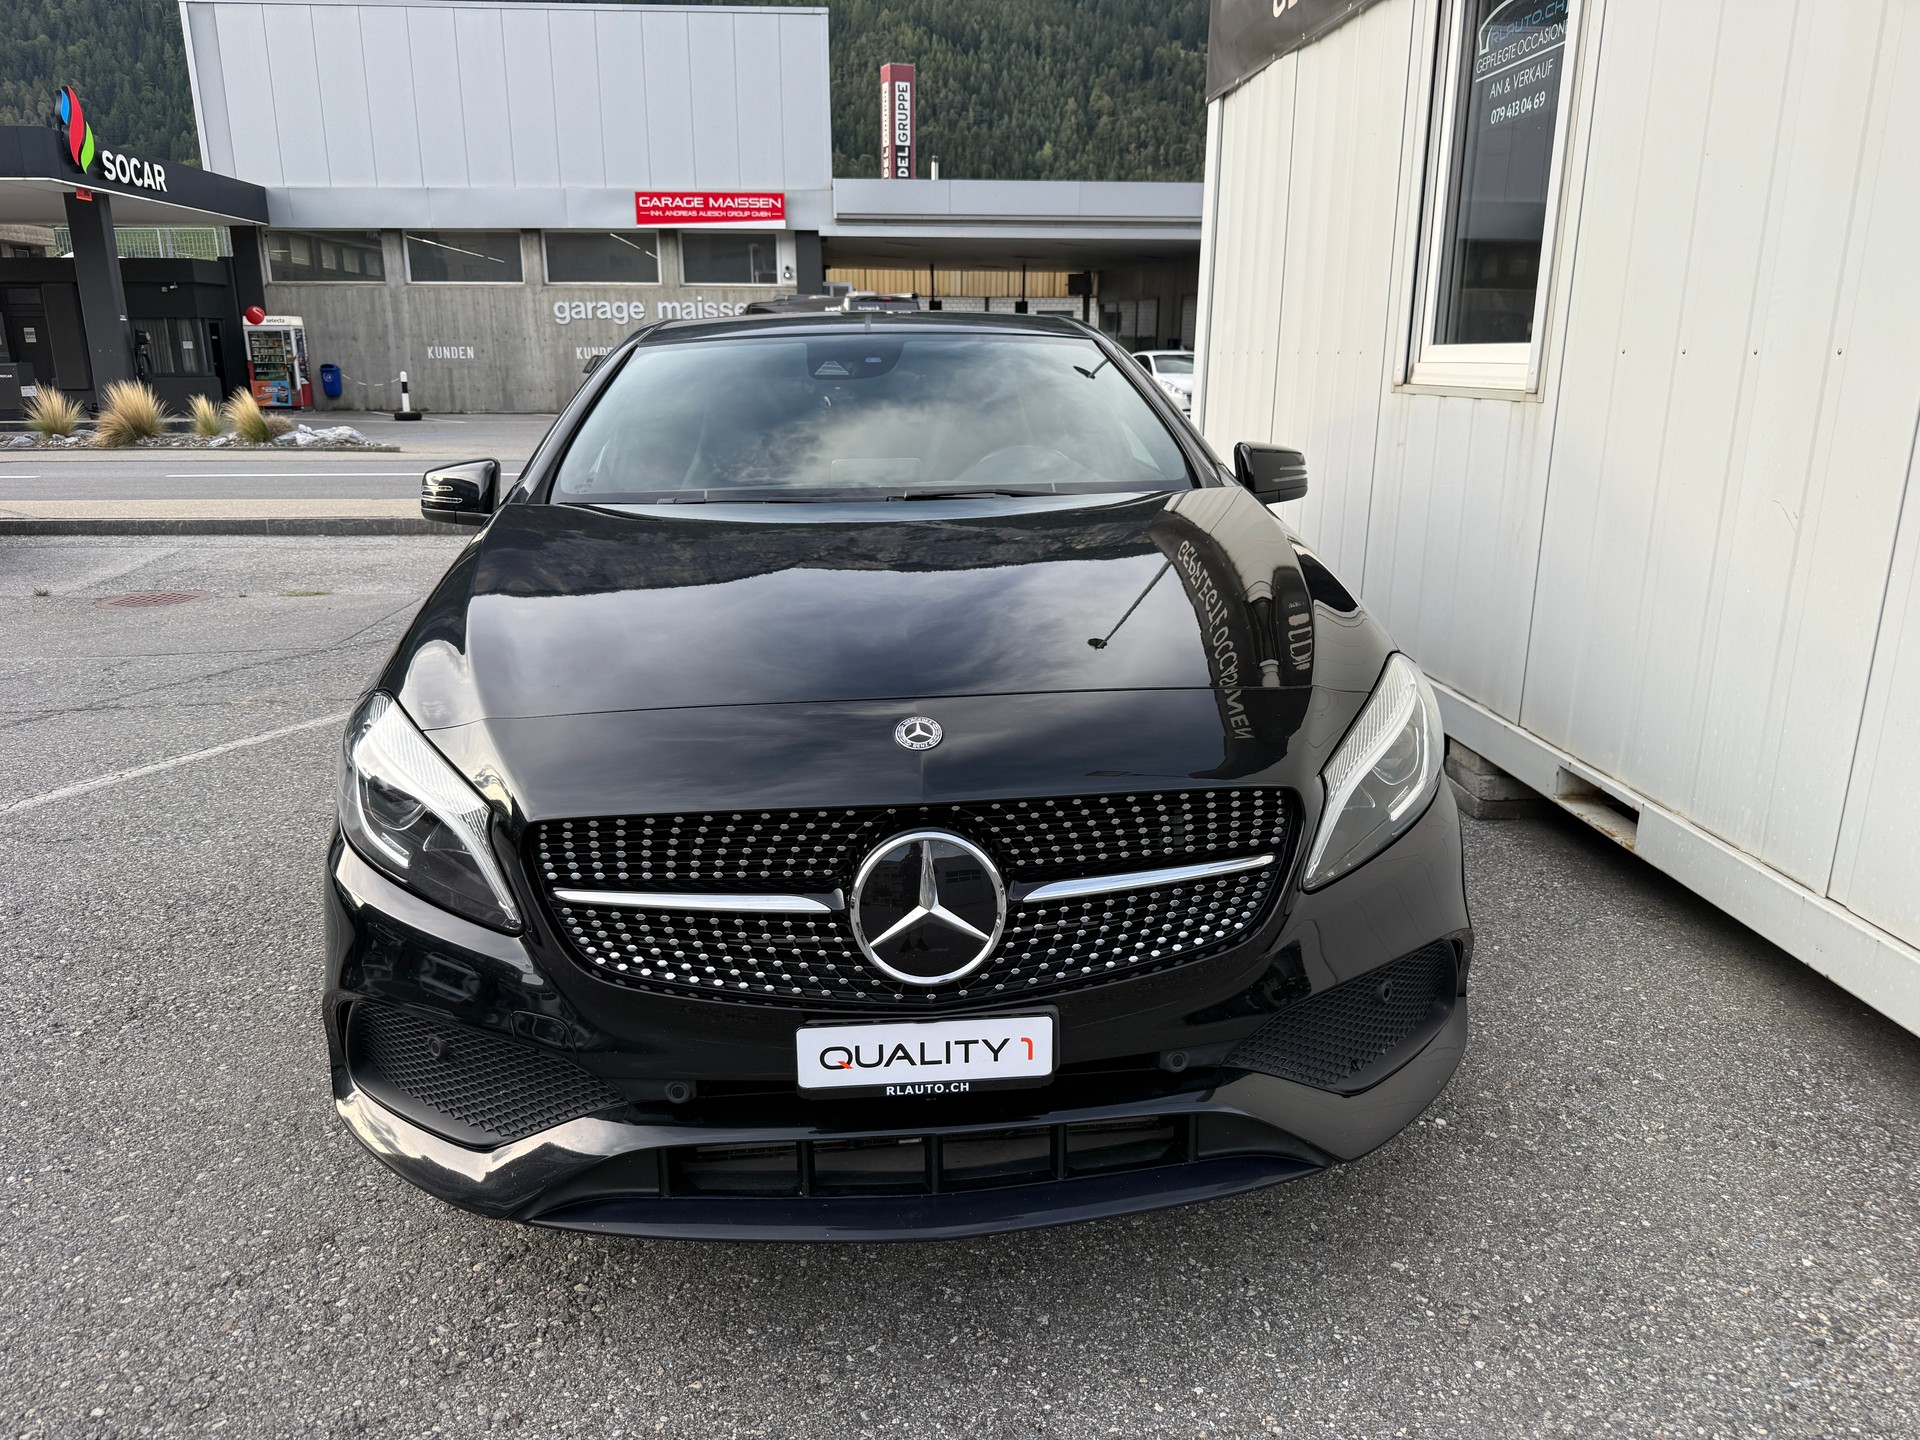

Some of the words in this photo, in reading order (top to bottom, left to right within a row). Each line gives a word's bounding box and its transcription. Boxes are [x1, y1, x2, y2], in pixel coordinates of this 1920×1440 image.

[1490, 0, 1565, 46] RLAUTO.CH
[1476, 43, 1517, 74] GEPFLEGTE
[1517, 19, 1568, 56] OCCASION
[1489, 82, 1503, 99] AN
[1504, 77, 1511, 94] &
[1513, 58, 1554, 90] VERKAUF
[897, 84, 909, 143] GRUPPE
[1490, 106, 1506, 125] 079
[1506, 100, 1520, 119] 413
[1520, 96, 1532, 114] 04
[1533, 91, 1546, 108] 69
[101, 149, 168, 192] SOCAR
[897, 147, 909, 178] DEL
[638, 196, 705, 208] GARAGE
[708, 197, 782, 208] MAISSEN
[553, 300, 646, 325] garage
[657, 296, 747, 319] maisse
[427, 346, 475, 359] KUNDEN
[575, 346, 614, 360] KUND
[819, 1037, 1011, 1071] QUALITY
[1020, 1037, 1034, 1061] 1
[886, 1081, 970, 1096] RLAUTO.CH
